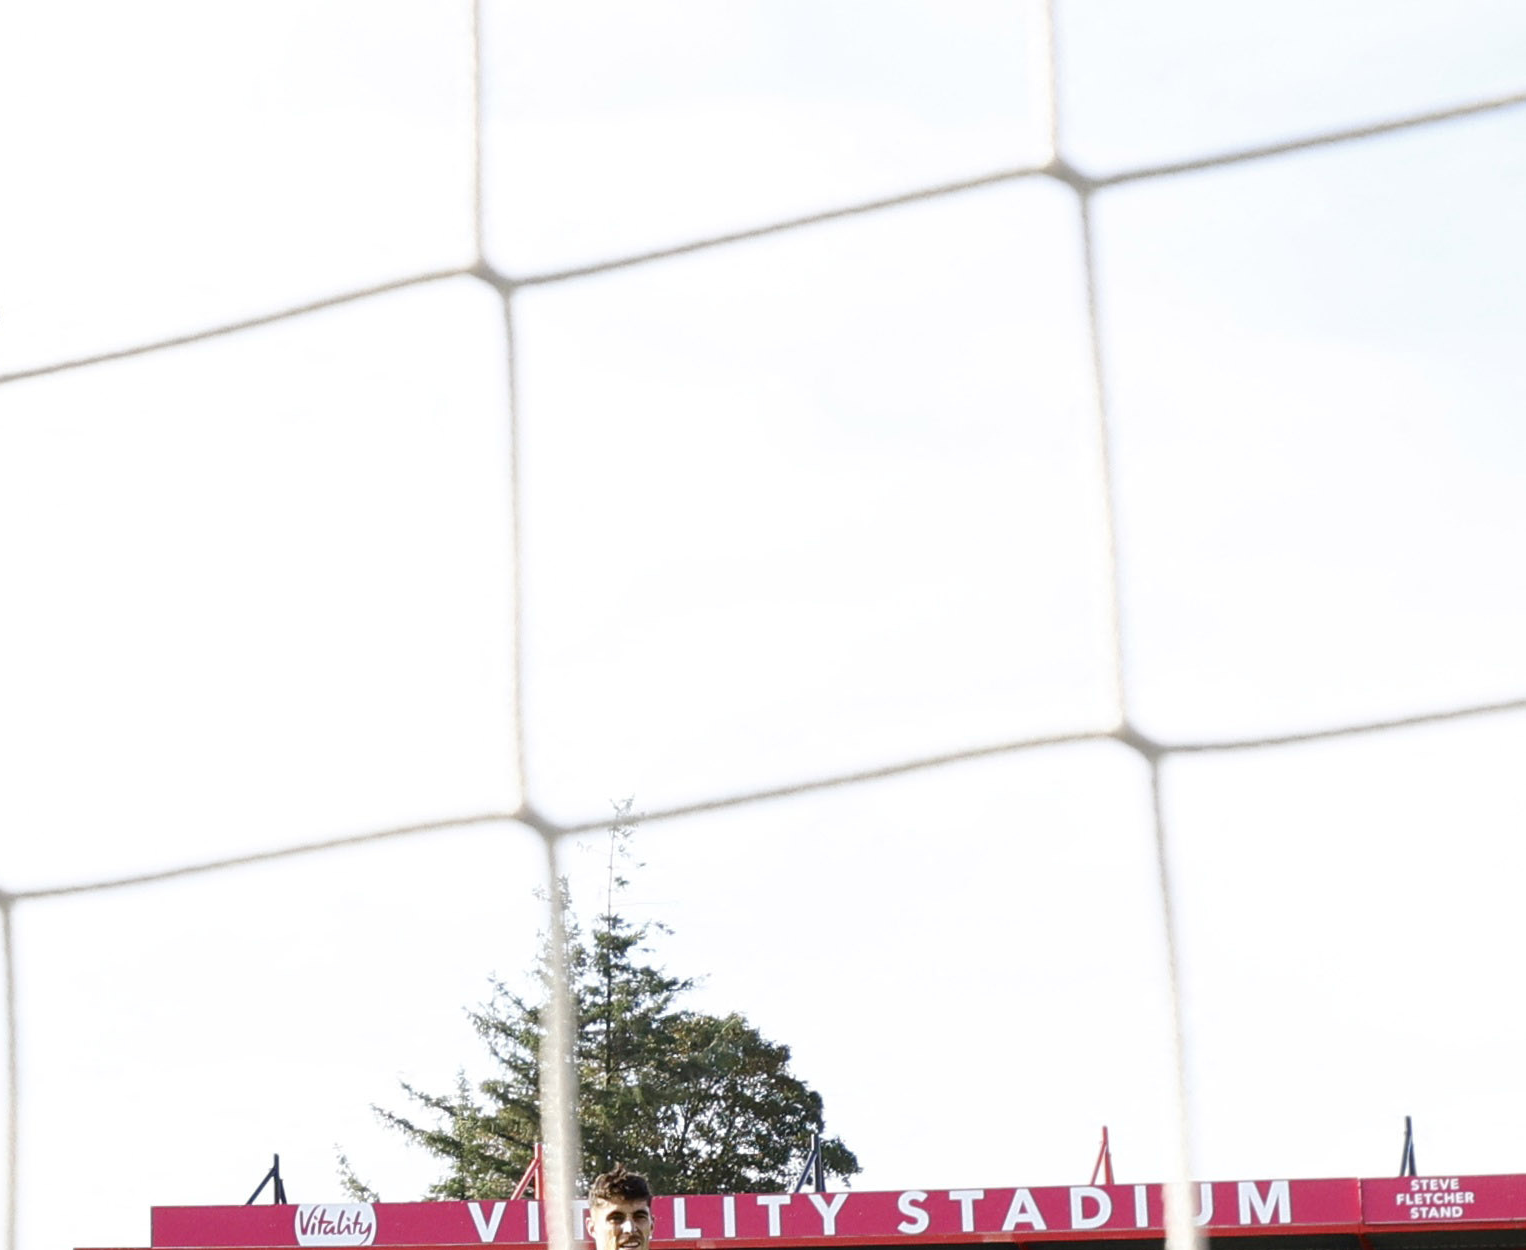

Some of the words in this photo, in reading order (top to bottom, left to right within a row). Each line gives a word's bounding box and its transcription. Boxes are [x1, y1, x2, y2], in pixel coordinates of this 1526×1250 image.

[1410, 1178, 1460, 1192] STEVE
[1396, 1191, 1475, 1206] FLETCHER
[467, 1194, 850, 1244] VITLITY
[1409, 1206, 1464, 1219] STAND
[299, 1204, 373, 1246] Vitality
